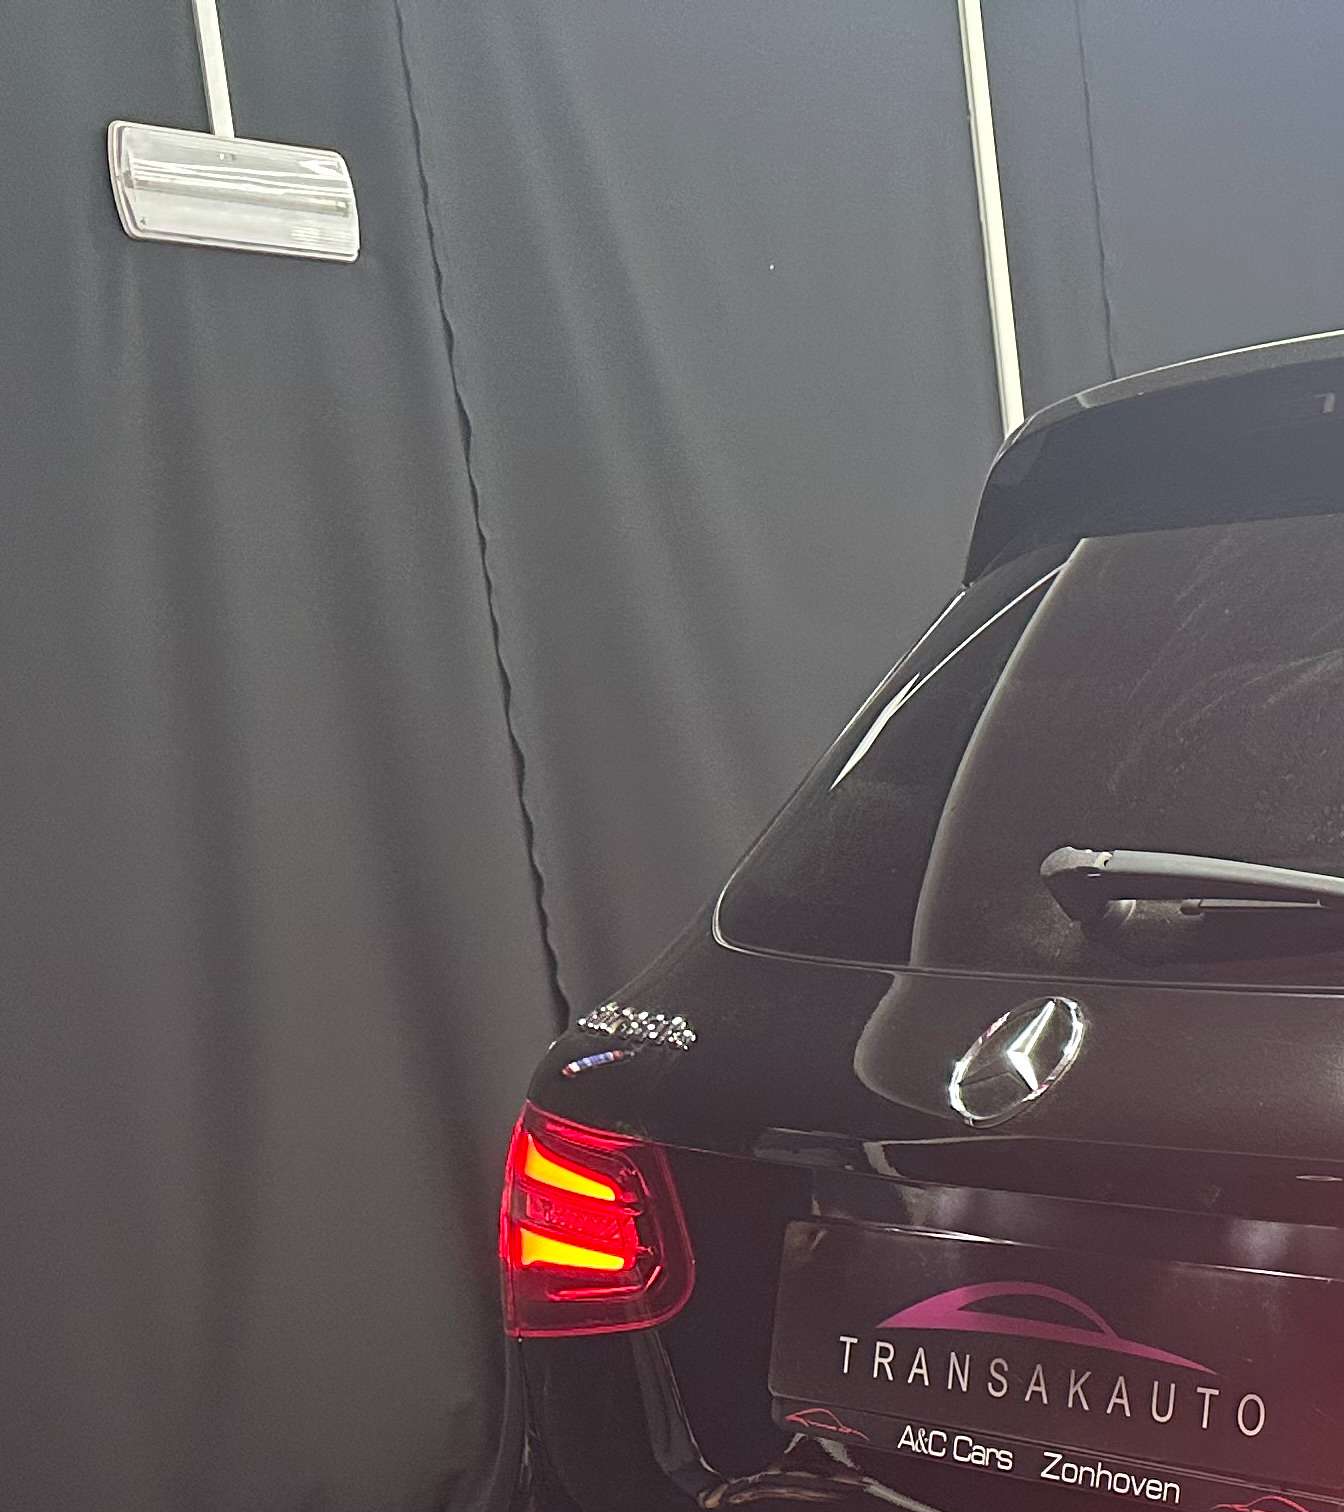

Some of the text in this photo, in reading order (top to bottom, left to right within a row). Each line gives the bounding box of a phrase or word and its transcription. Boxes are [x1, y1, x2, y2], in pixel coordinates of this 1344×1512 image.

[838, 1336, 1267, 1437] TRANSAKAUTO
[896, 1425, 1182, 1505] A&C Cars Zonhoven
